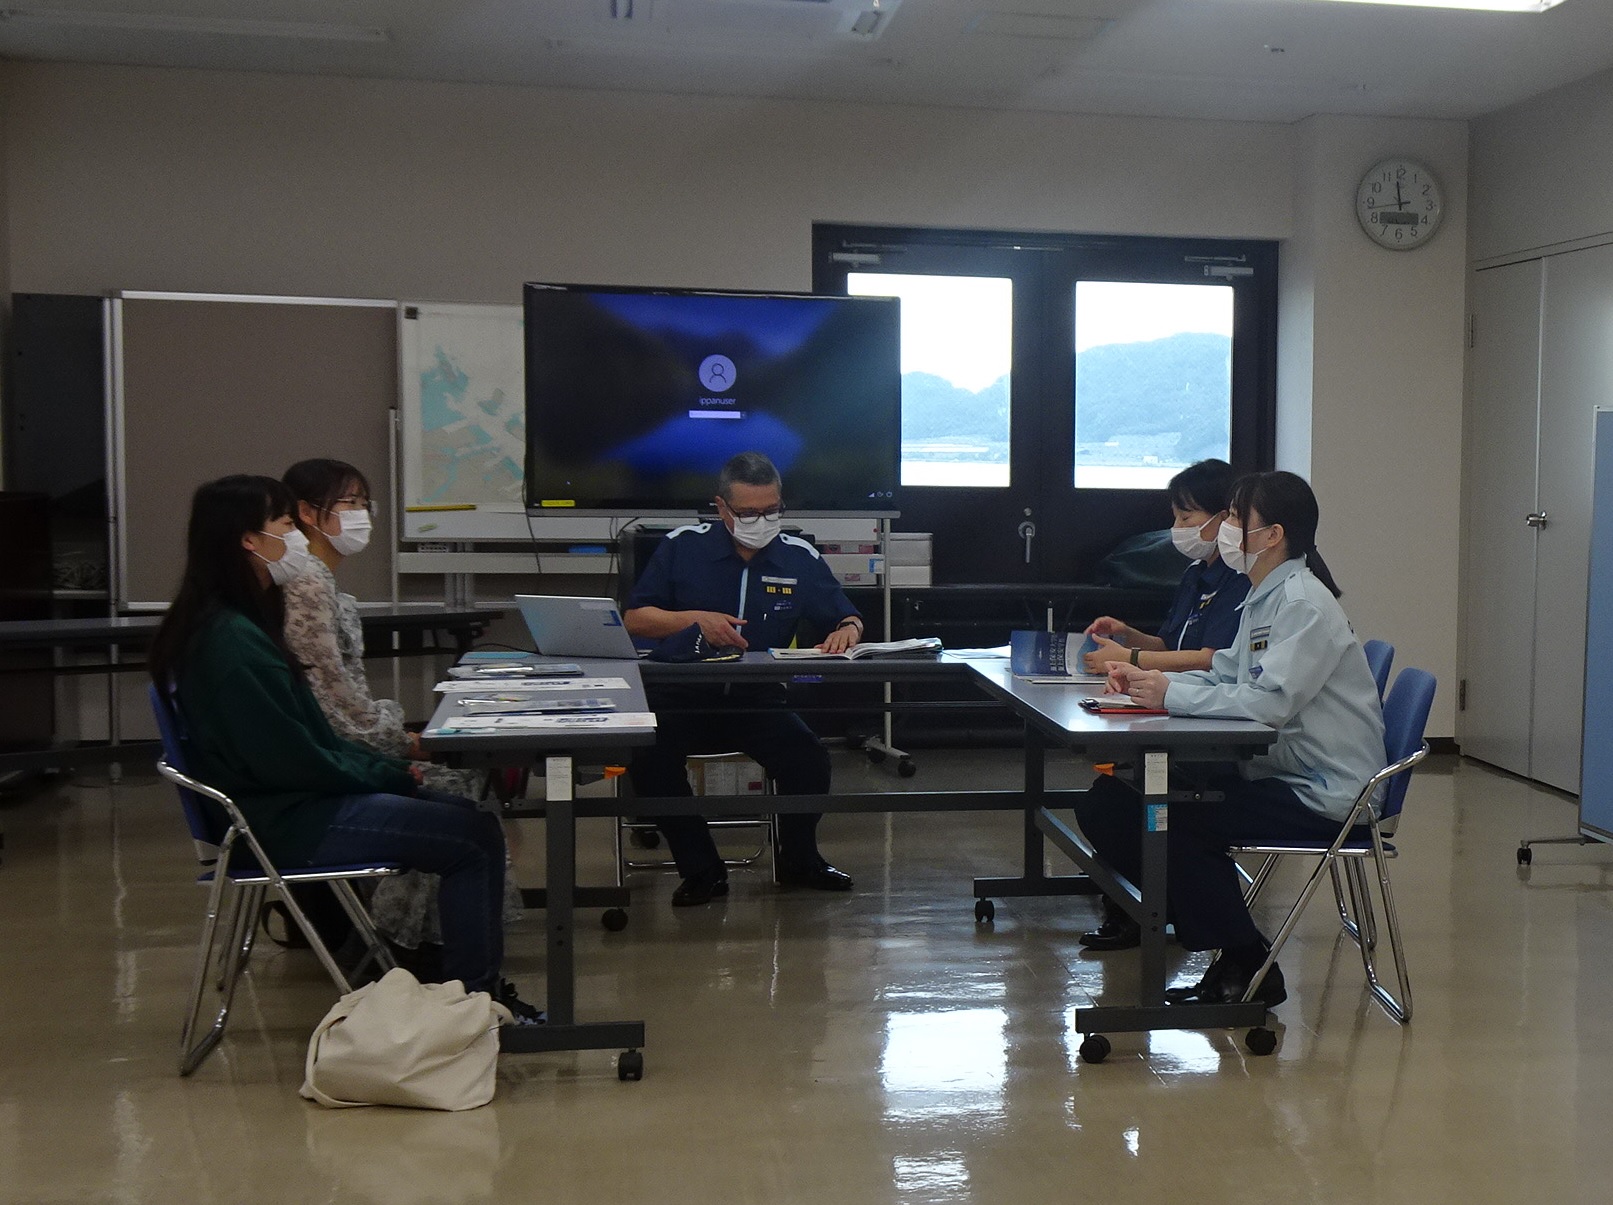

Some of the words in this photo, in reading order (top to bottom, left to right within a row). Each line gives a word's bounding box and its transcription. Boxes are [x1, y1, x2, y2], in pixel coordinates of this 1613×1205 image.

[1383, 171, 1391, 182] 11
[1396, 168, 1406, 180] 12
[1371, 181, 1382, 193] 10
[1422, 184, 1430, 196] 2
[1367, 196, 1375, 208] 9
[1426, 199, 1433, 211] 3
[1370, 212, 1378, 224] 8
[1421, 215, 1428, 225] 4
[1380, 225, 1388, 236] 7
[1395, 228, 1403, 240] 6
[1410, 226, 1418, 236] 5
